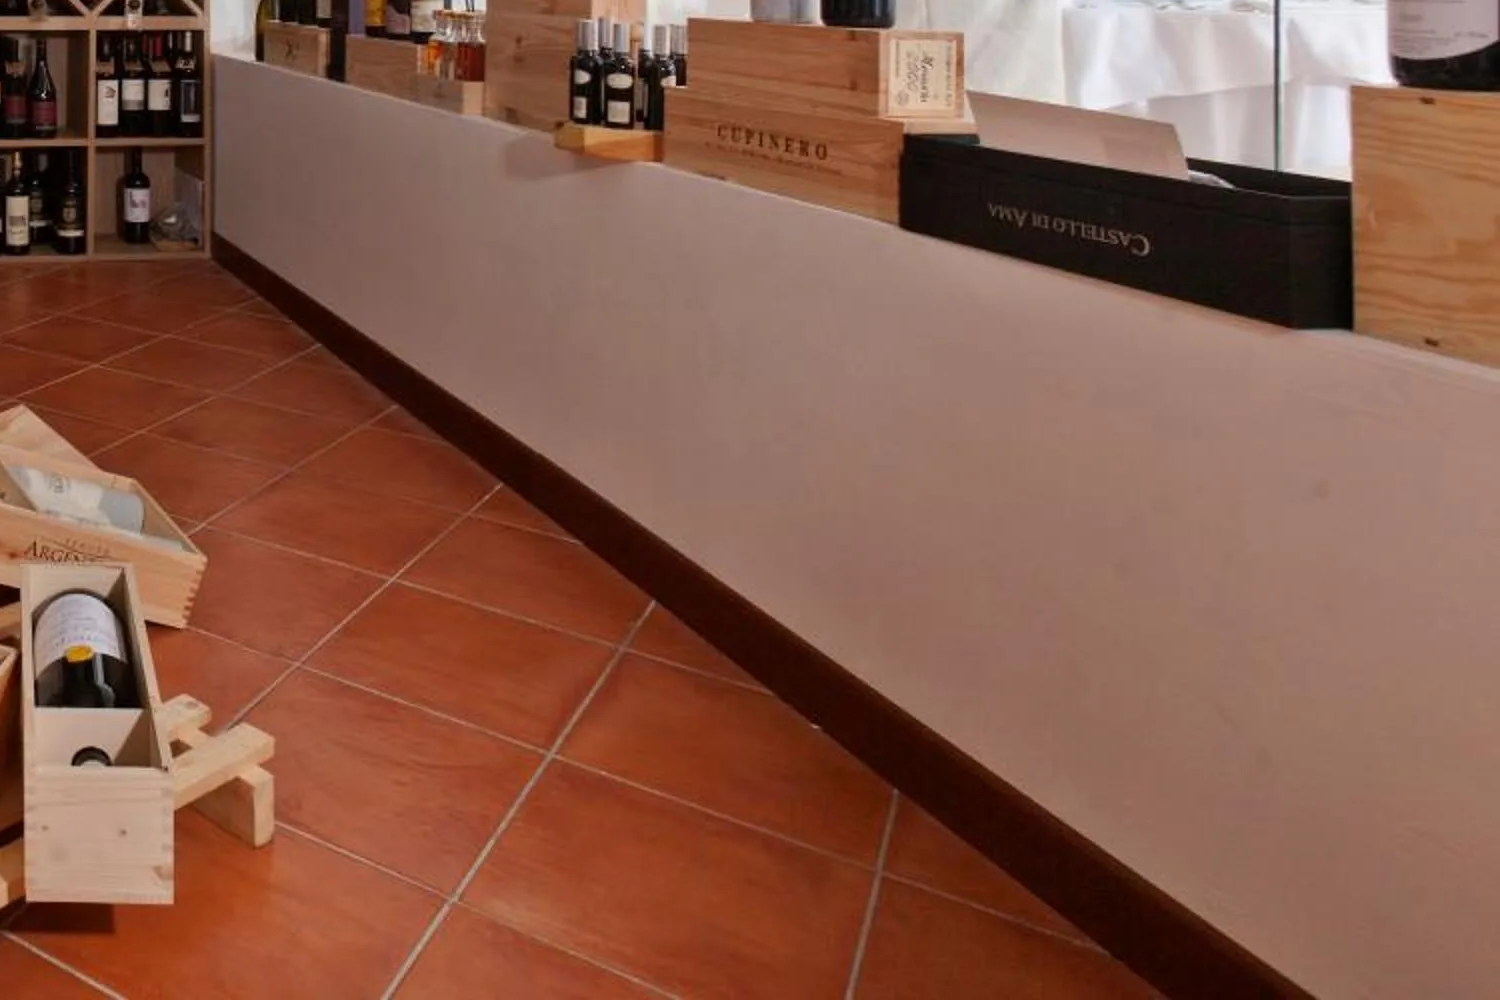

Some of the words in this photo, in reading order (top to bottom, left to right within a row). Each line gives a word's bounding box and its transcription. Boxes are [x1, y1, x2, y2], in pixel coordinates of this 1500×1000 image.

[987, 201, 1030, 229] AMA
[1031, 211, 1049, 230] DI
[1051, 216, 1151, 257] CASTELLO
